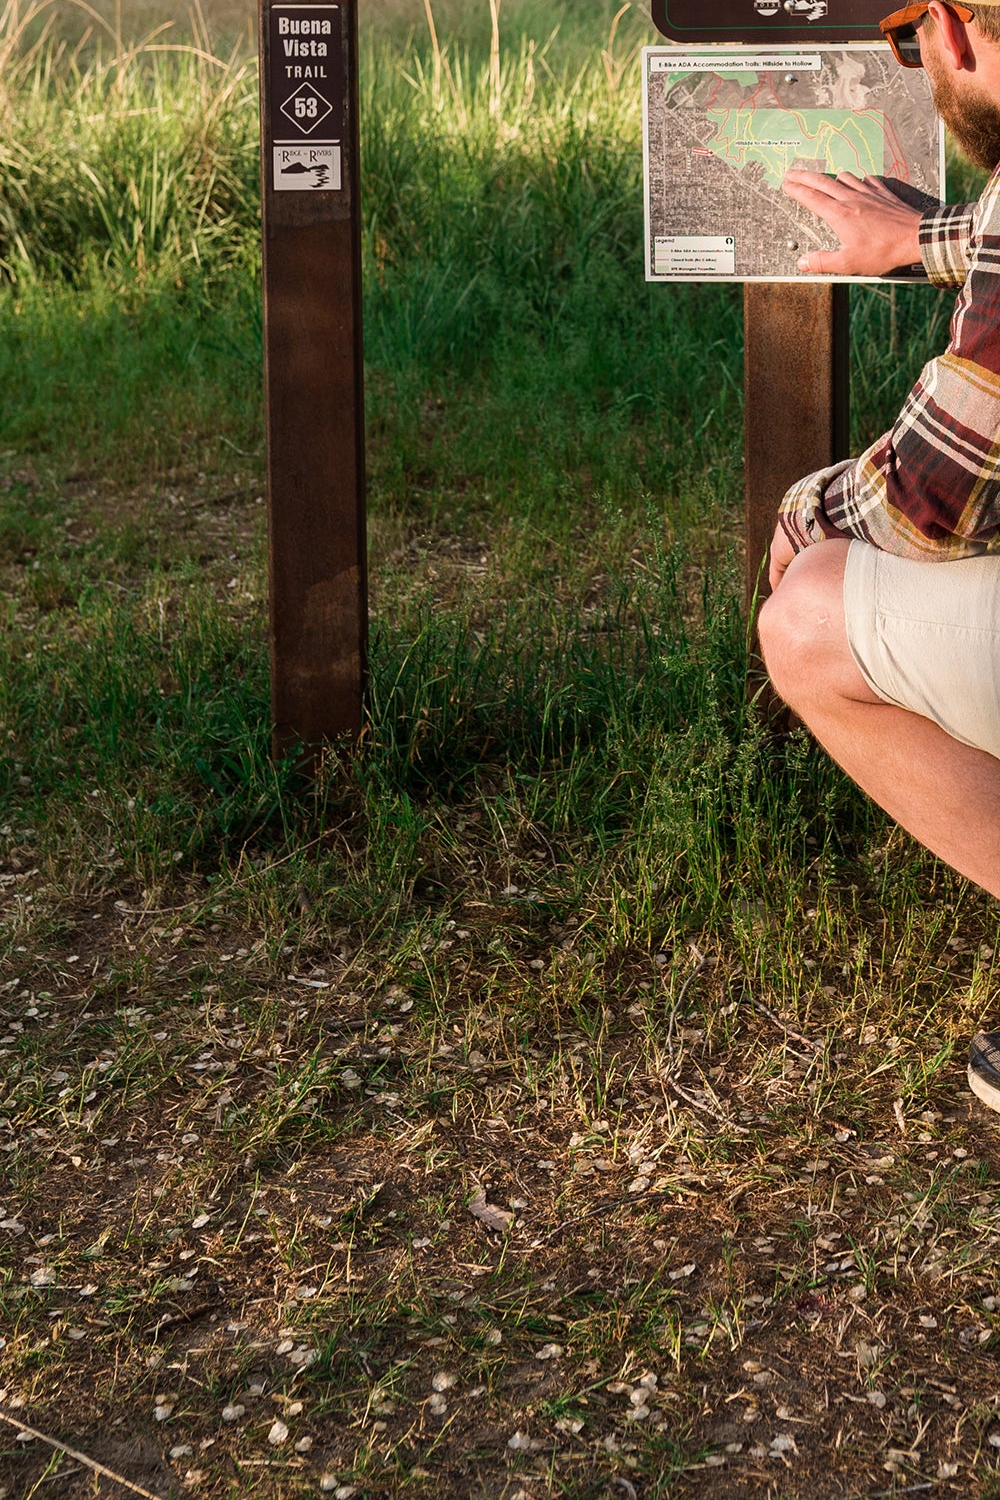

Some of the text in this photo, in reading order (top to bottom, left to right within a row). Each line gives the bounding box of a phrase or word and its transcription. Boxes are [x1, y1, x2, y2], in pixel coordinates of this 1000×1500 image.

[278, 17, 331, 35] Buena
[283, 39, 328, 57] Vista
[285, 66, 327, 78] TRAIL
[294, 97, 318, 118] 53
